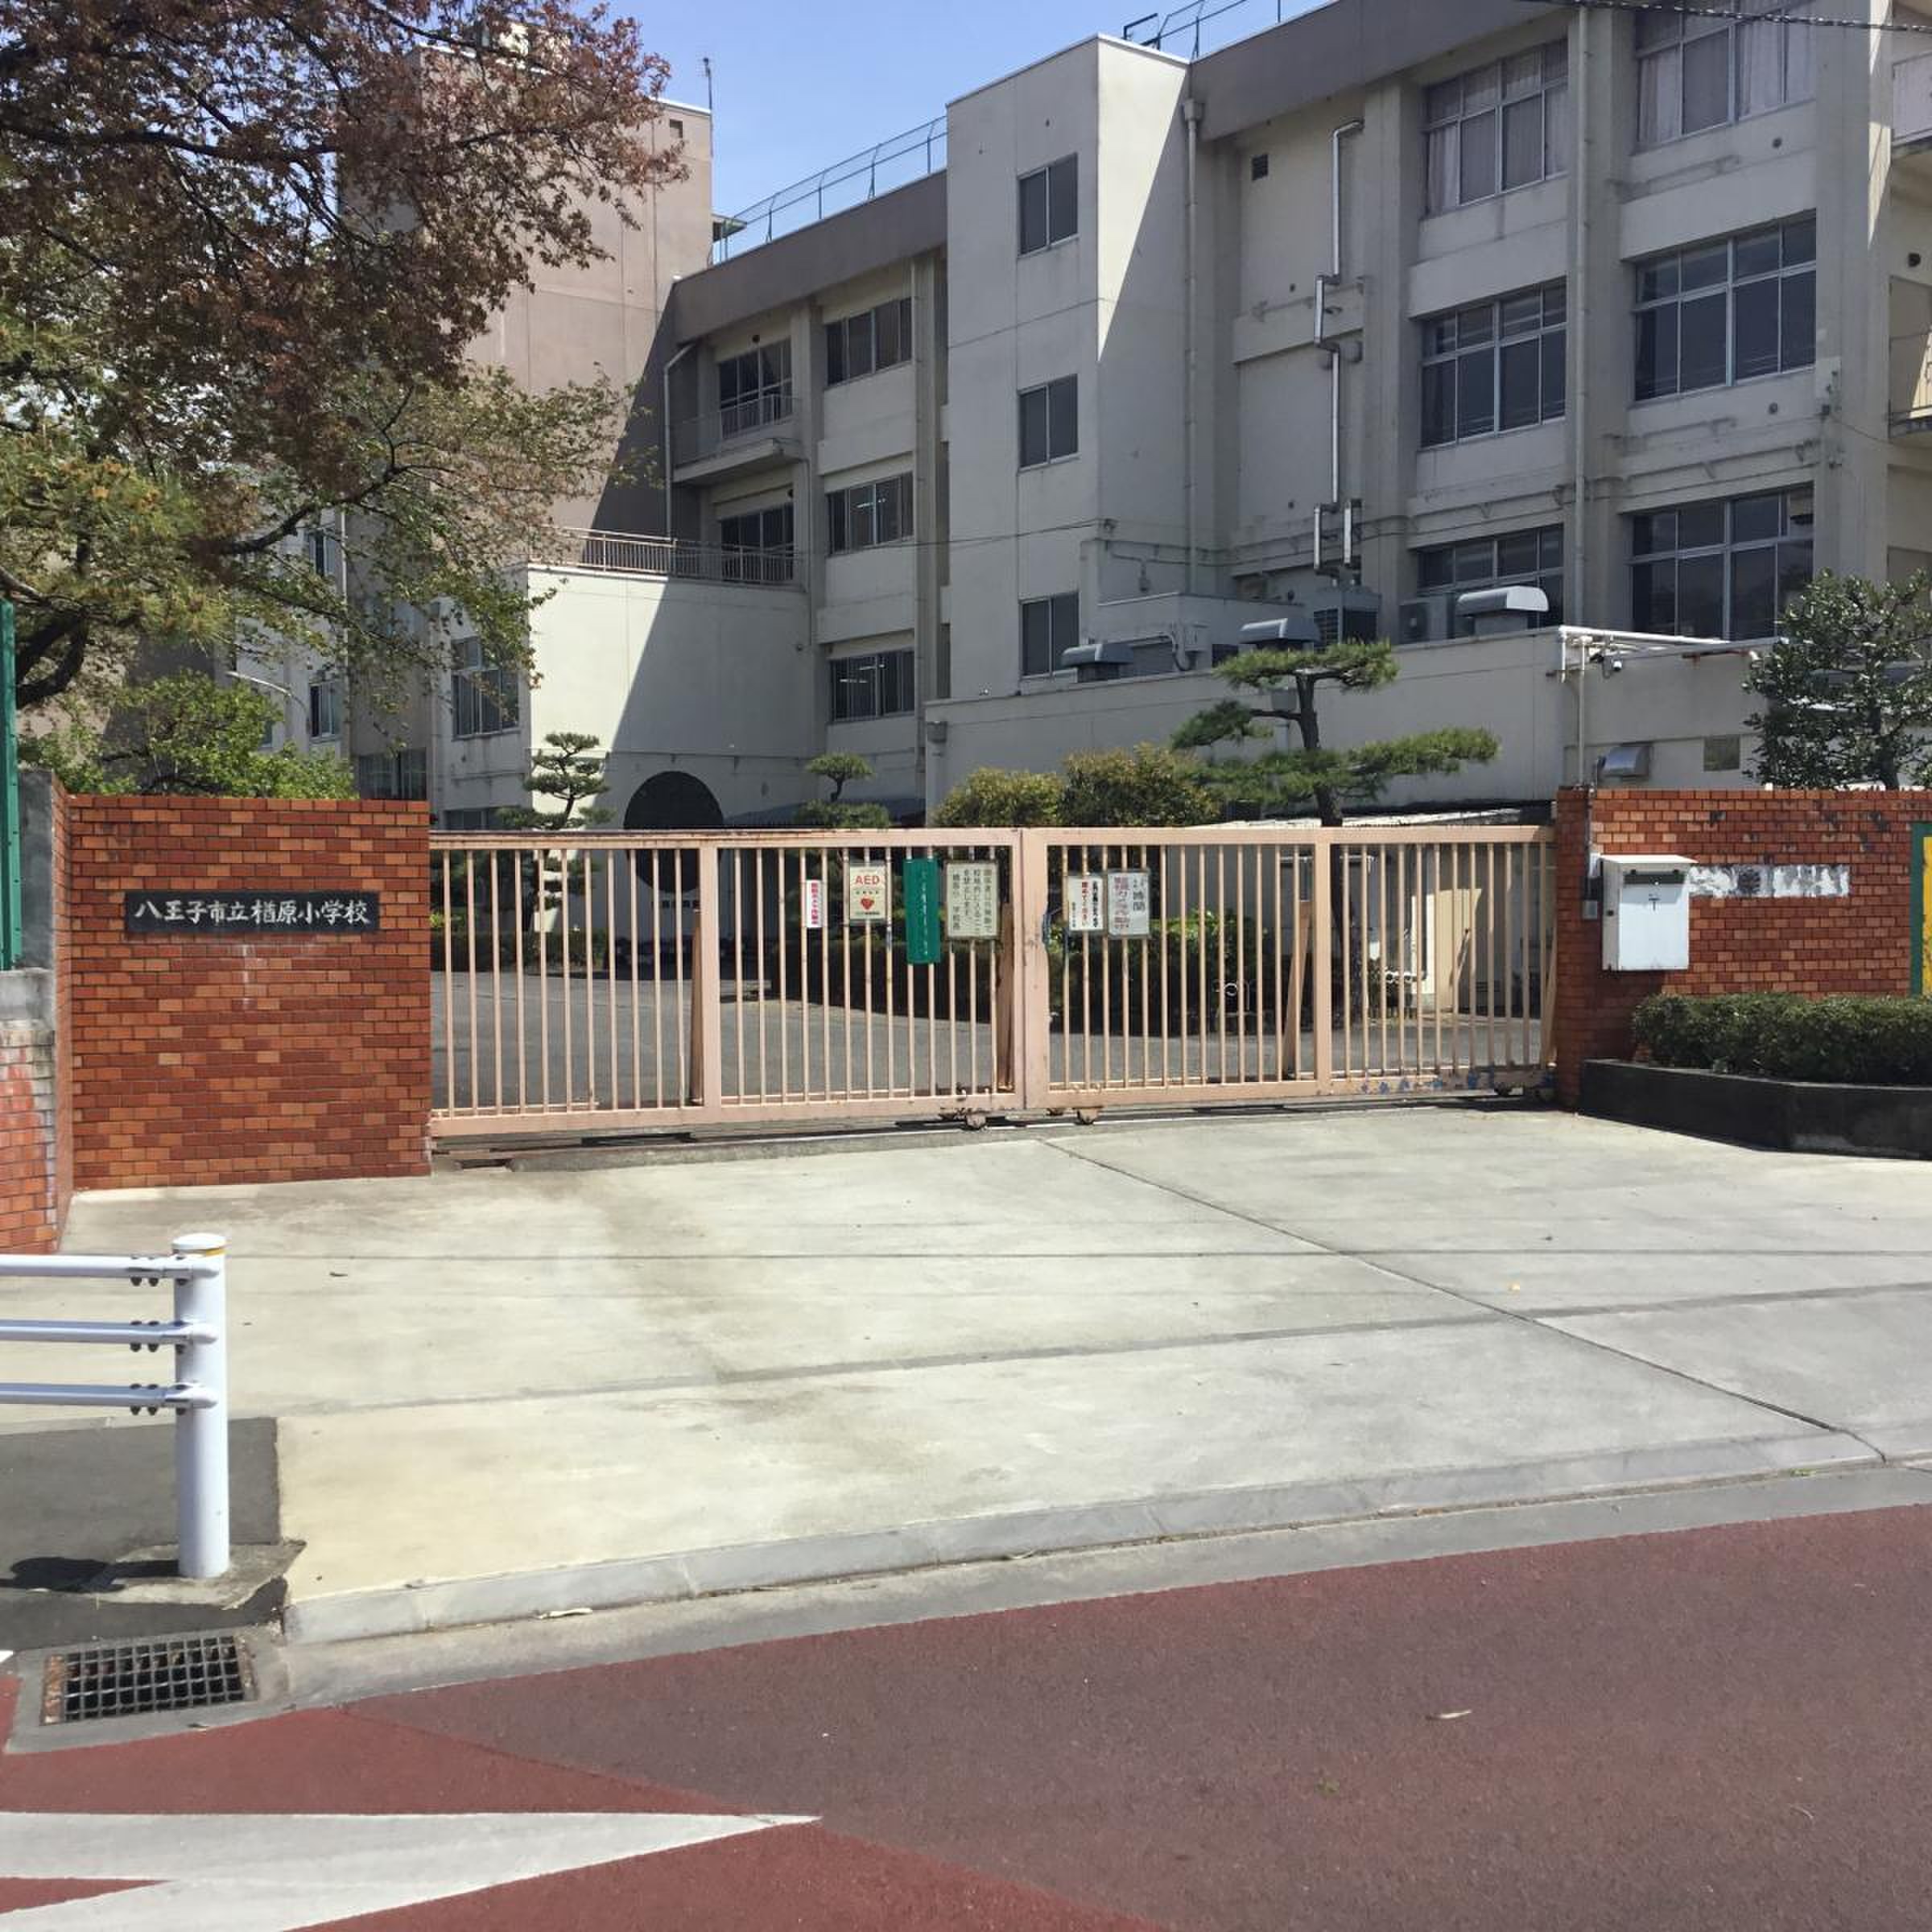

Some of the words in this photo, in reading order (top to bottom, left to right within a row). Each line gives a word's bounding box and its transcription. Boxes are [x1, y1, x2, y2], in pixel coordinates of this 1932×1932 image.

[855, 875, 879, 886] AED
[134, 898, 370, 925] 八王子市立楢原小学校
